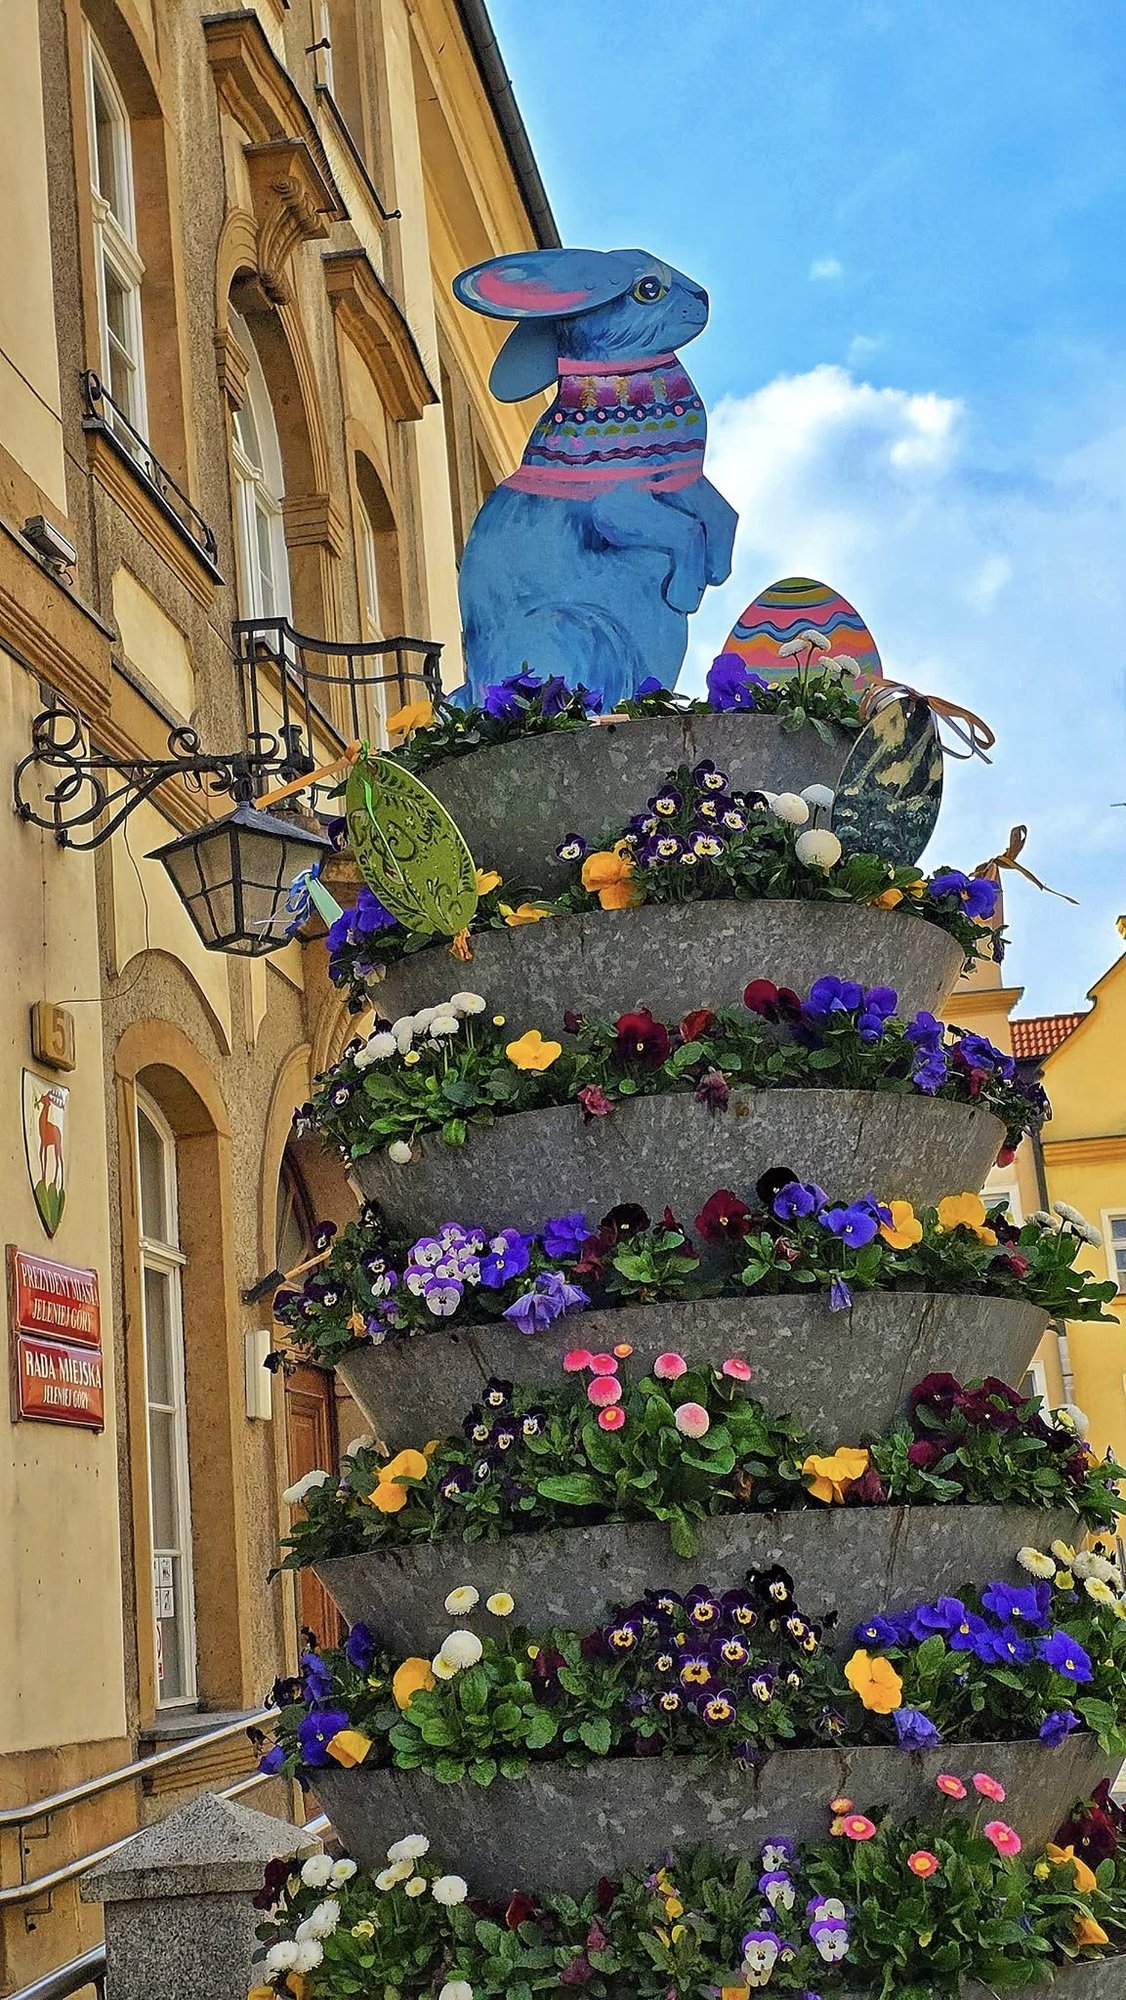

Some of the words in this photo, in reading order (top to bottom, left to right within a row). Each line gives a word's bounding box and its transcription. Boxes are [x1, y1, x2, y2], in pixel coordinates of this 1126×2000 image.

[52, 1008, 65, 1056] 5
[21, 1263, 71, 1299] PREZYDENT
[32, 1298, 70, 1327] JELENIEJ
[71, 1303, 94, 1332] GÓRY
[25, 1350, 56, 1380] RADA
[58, 1356, 102, 1389] MIEJSKA
